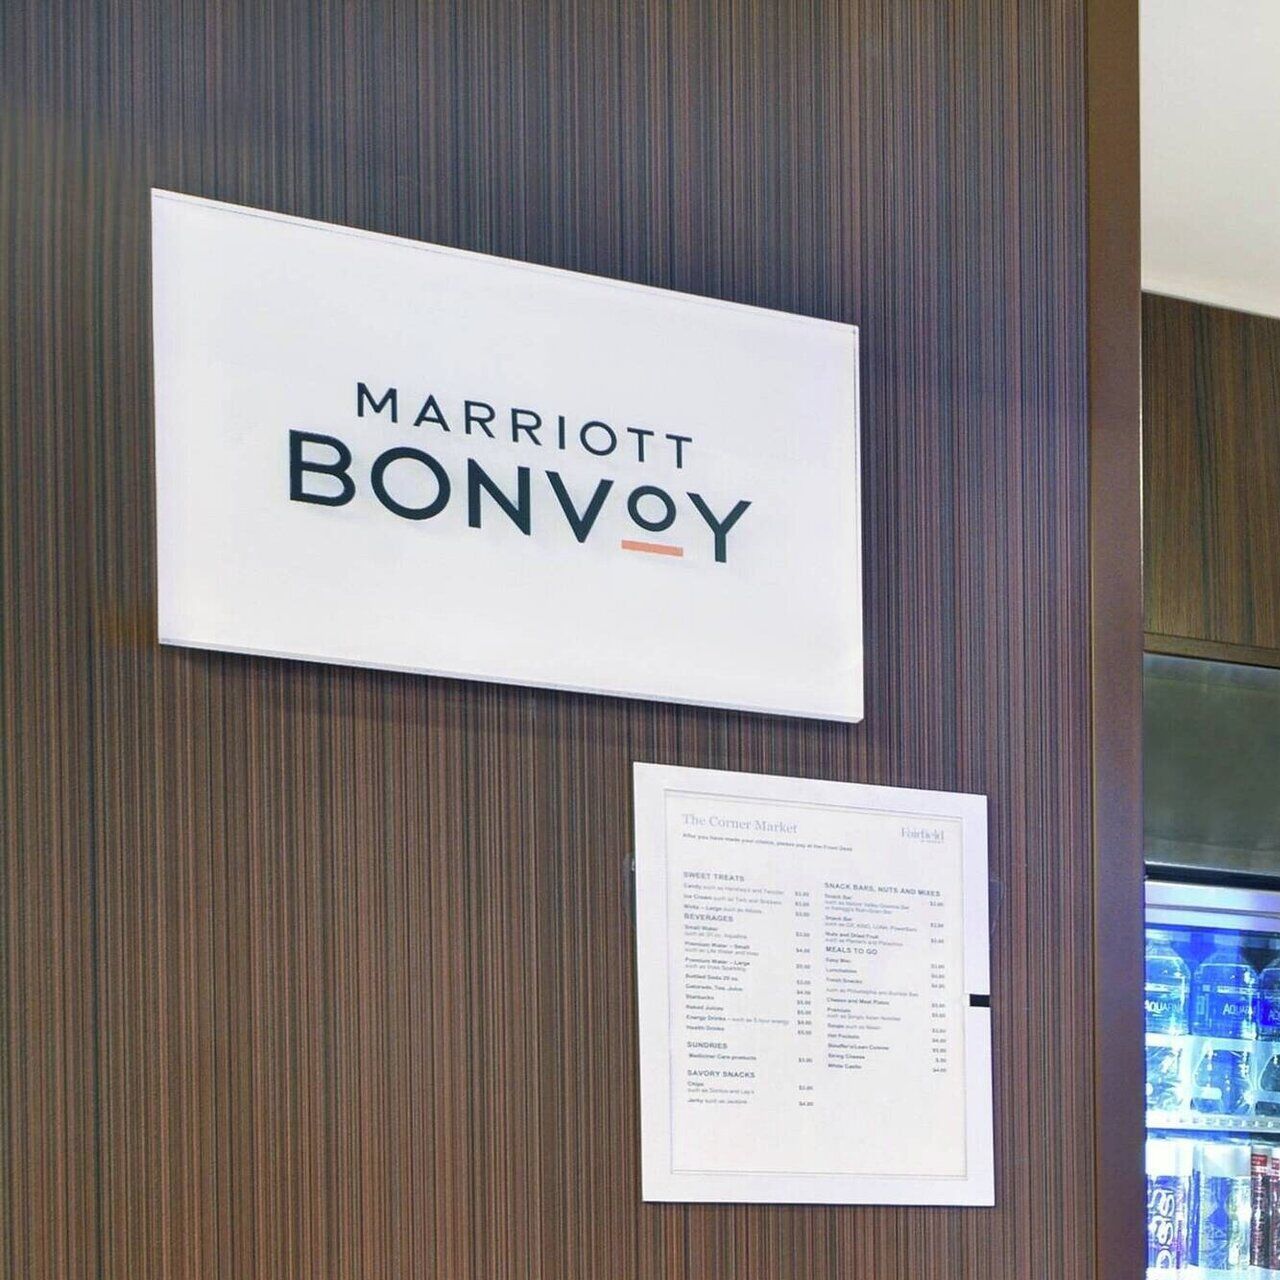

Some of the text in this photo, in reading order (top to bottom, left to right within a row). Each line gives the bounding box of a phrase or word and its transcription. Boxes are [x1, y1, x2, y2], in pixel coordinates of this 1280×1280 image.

[357, 381, 693, 469] MARRIOTT
[288, 429, 753, 564] BONVOY
[682, 814, 798, 835] The Corner Market
[683, 872, 745, 882] SWEET TREATS
[825, 882, 850, 890] SNACK
[684, 913, 734, 922] BEVERAGES
[826, 946, 852, 954] MEALS
[687, 1041, 728, 1049] SUNDRIES
[722, 1071, 756, 1079] SNACKS
